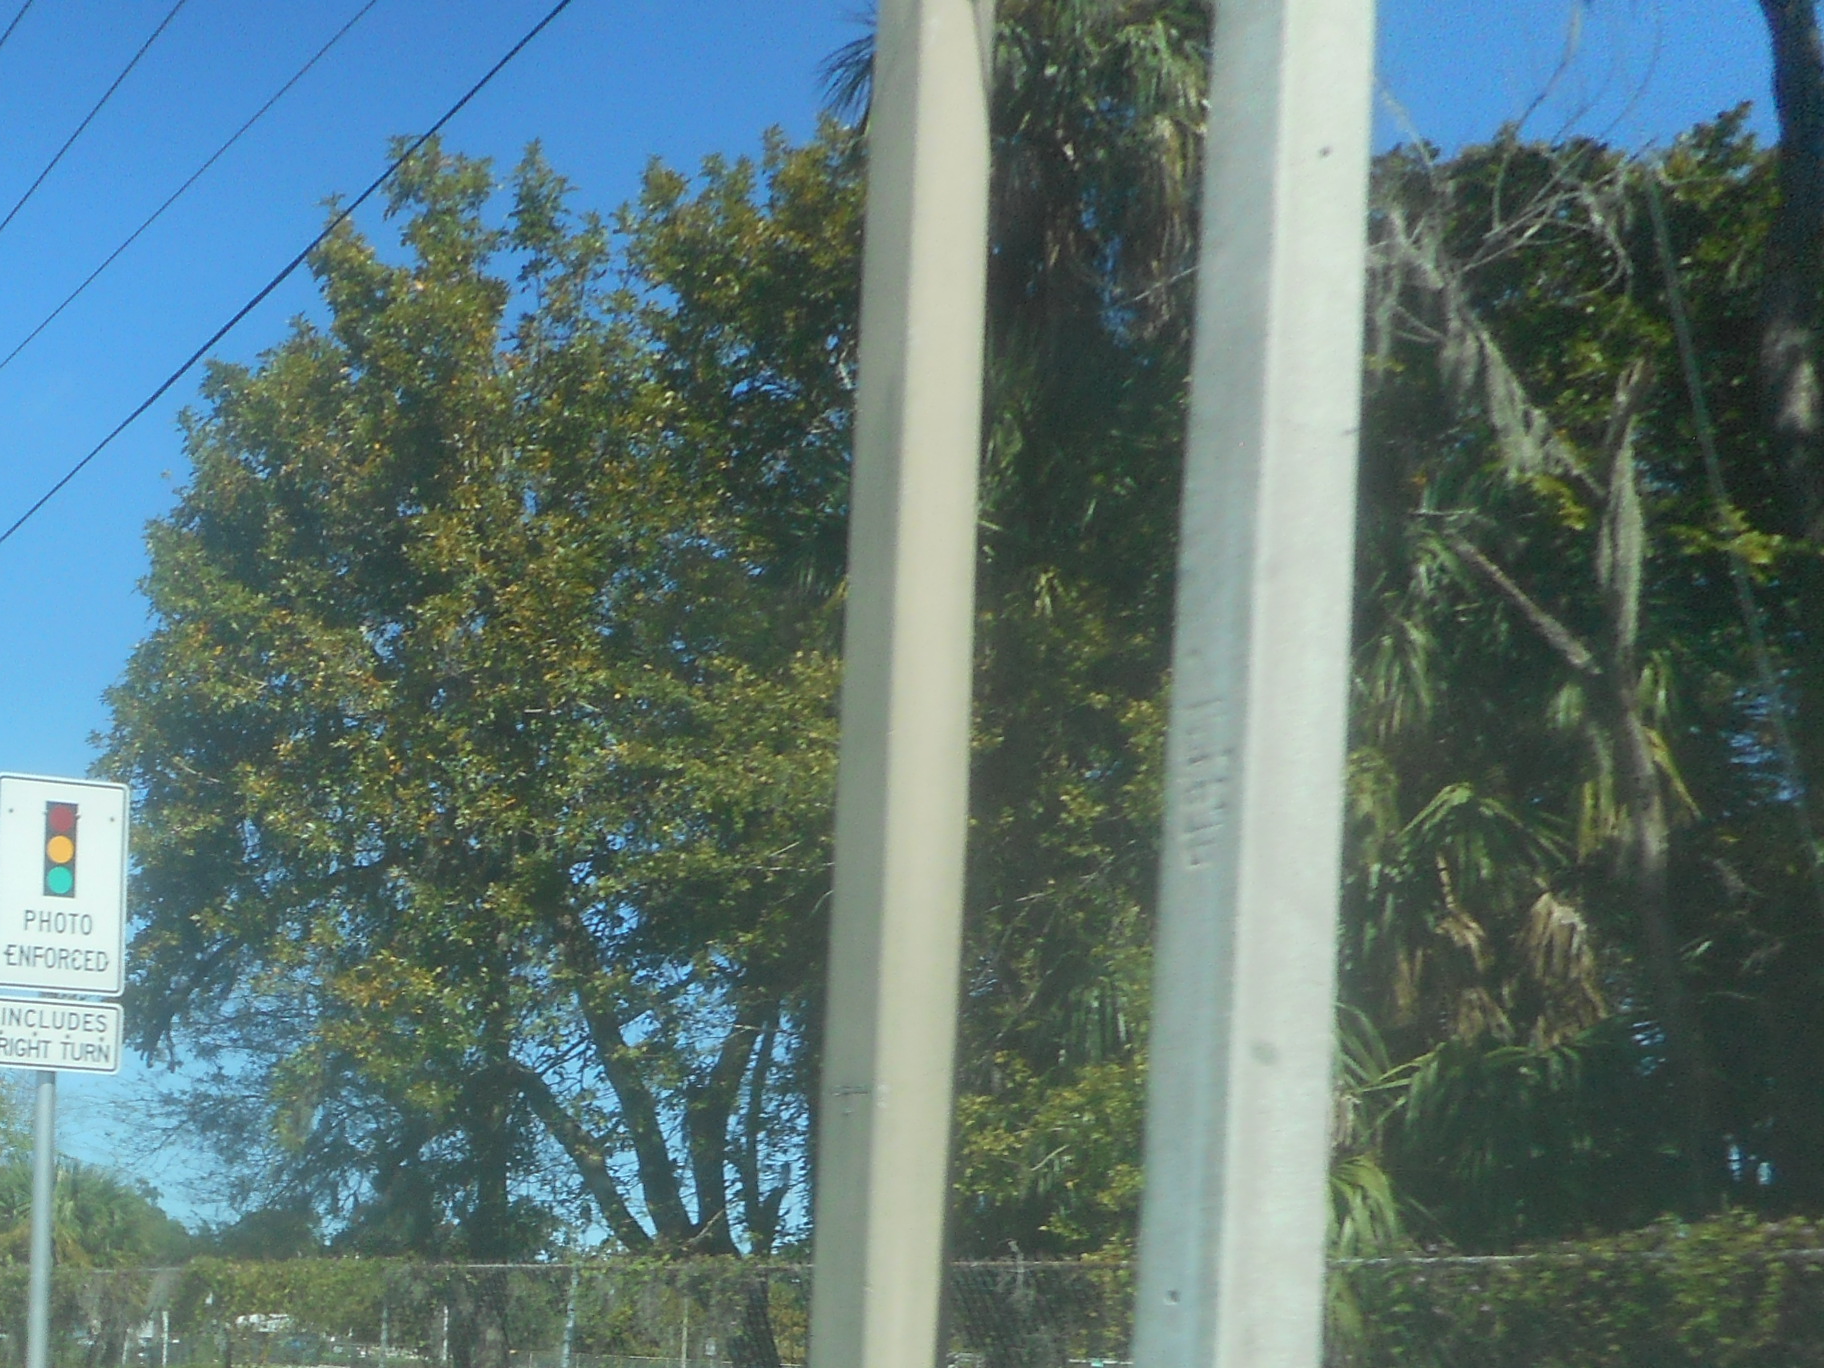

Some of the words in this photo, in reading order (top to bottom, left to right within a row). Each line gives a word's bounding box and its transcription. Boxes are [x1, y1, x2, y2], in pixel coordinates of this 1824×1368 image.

[24, 910, 92, 935] PHOTO
[5, 944, 107, 972] ENFORCED
[1, 1007, 107, 1033] INCLUDES
[60, 1041, 110, 1063] TURN
